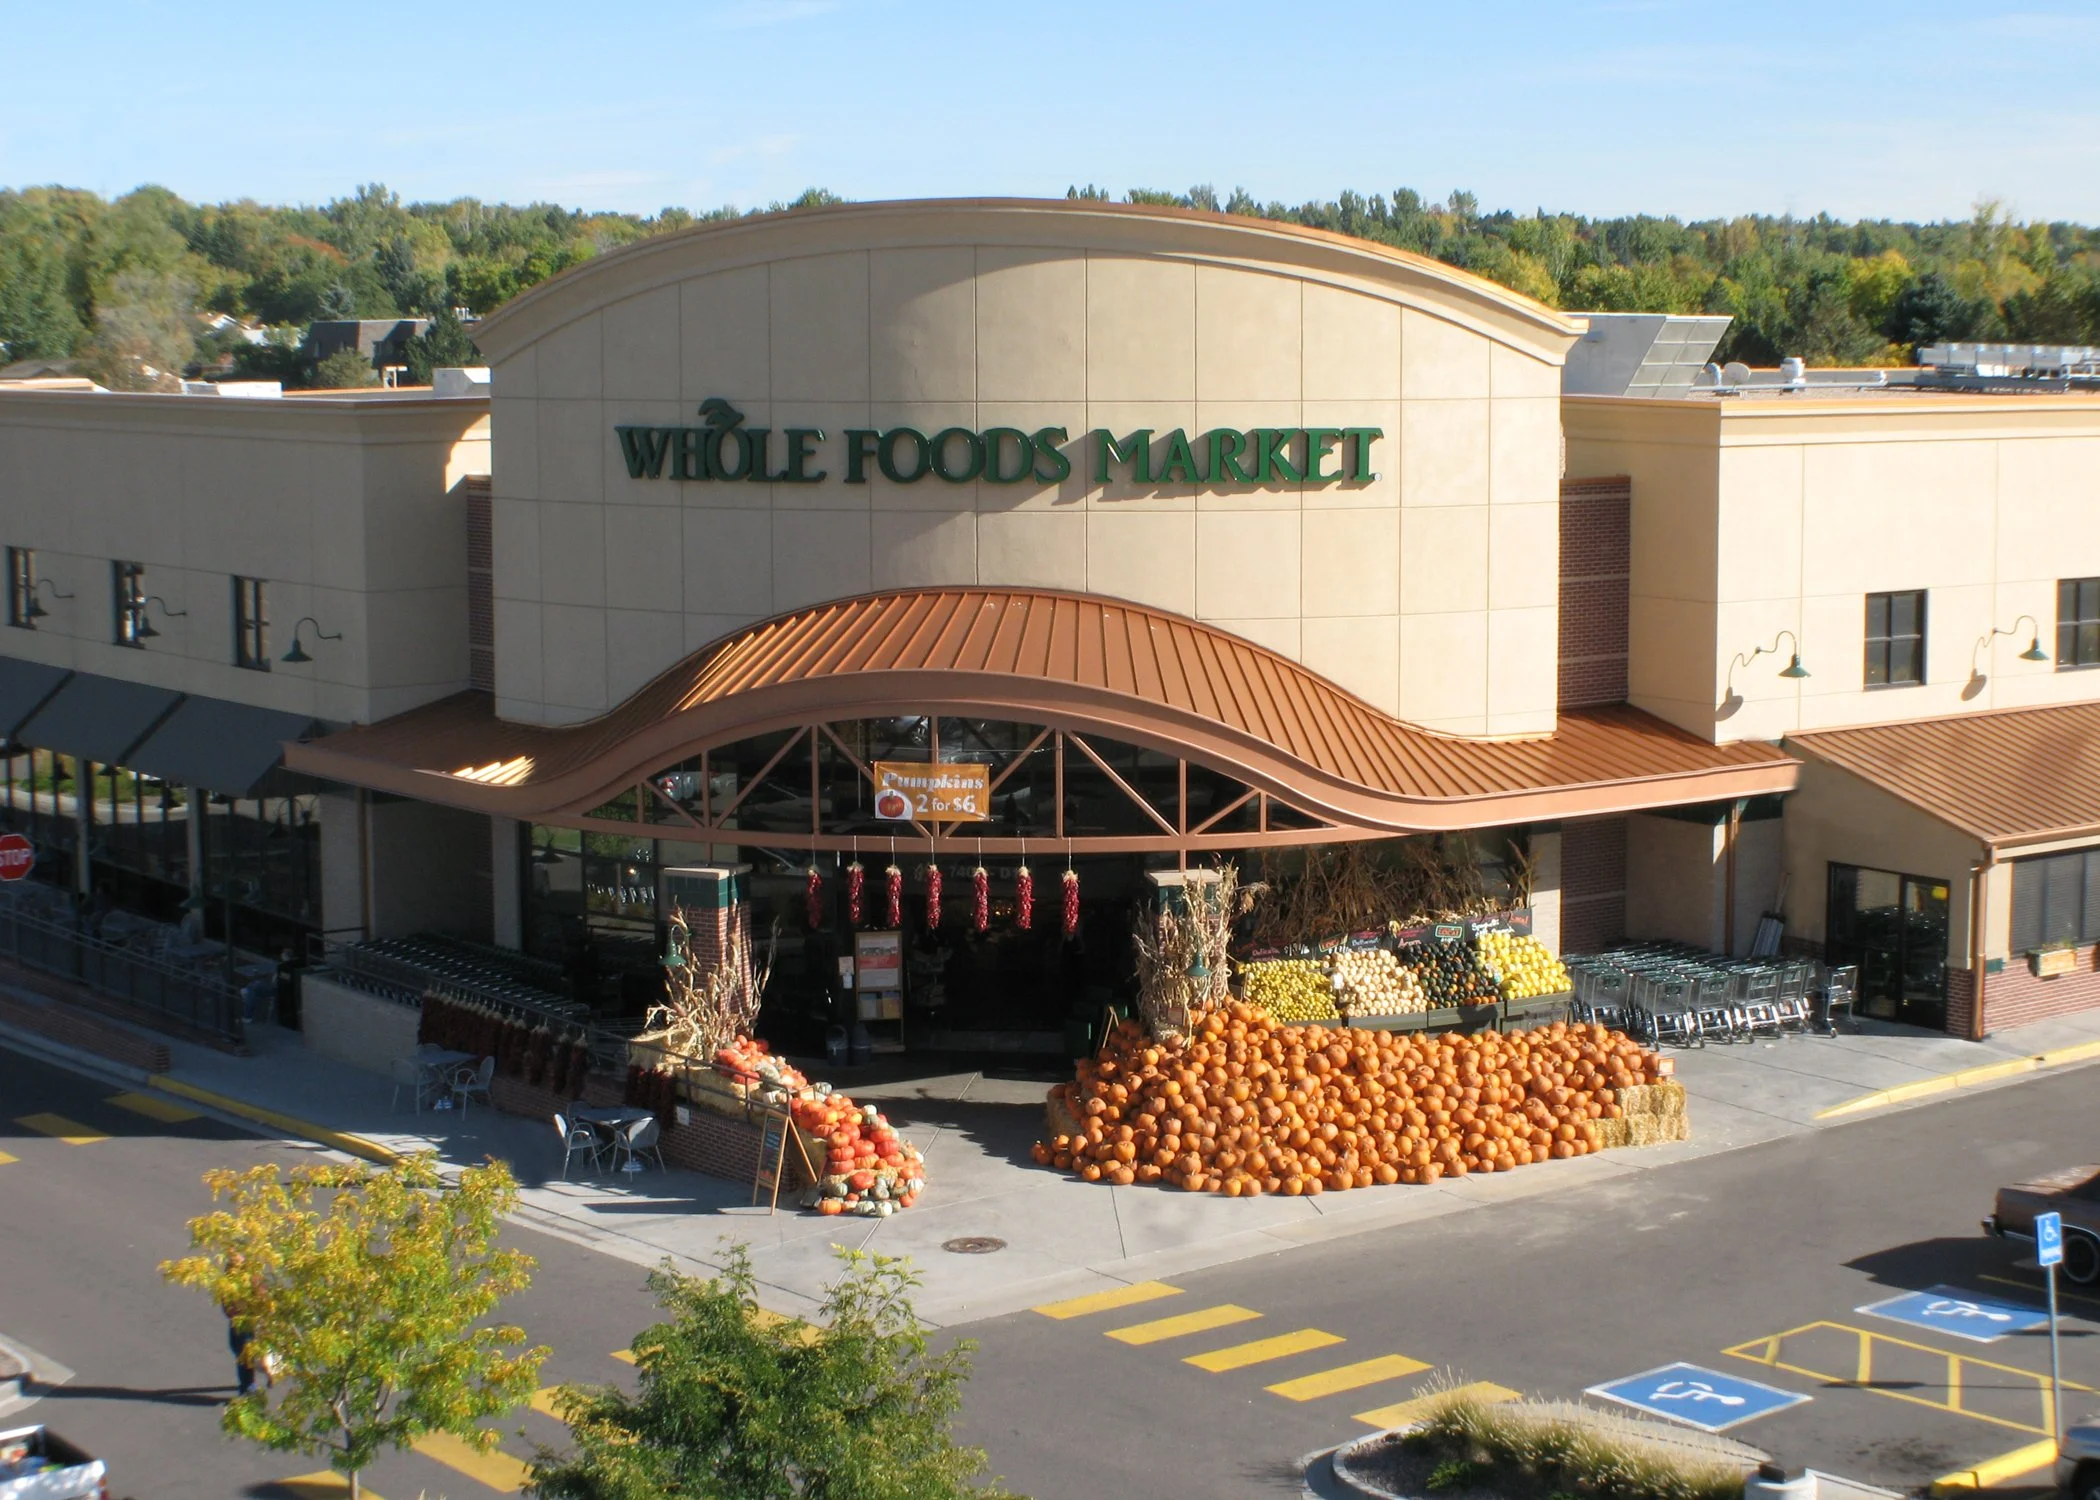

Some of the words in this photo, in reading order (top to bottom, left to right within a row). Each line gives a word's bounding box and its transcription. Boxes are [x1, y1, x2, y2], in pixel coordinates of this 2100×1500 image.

[614, 424, 826, 482] WHOLE
[843, 426, 1070, 483] FOODS
[1094, 427, 1384, 483] MARKET
[881, 771, 984, 791] Pumpkins
[916, 794, 929, 813] 2
[932, 798, 951, 811] for
[953, 795, 976, 814] $6
